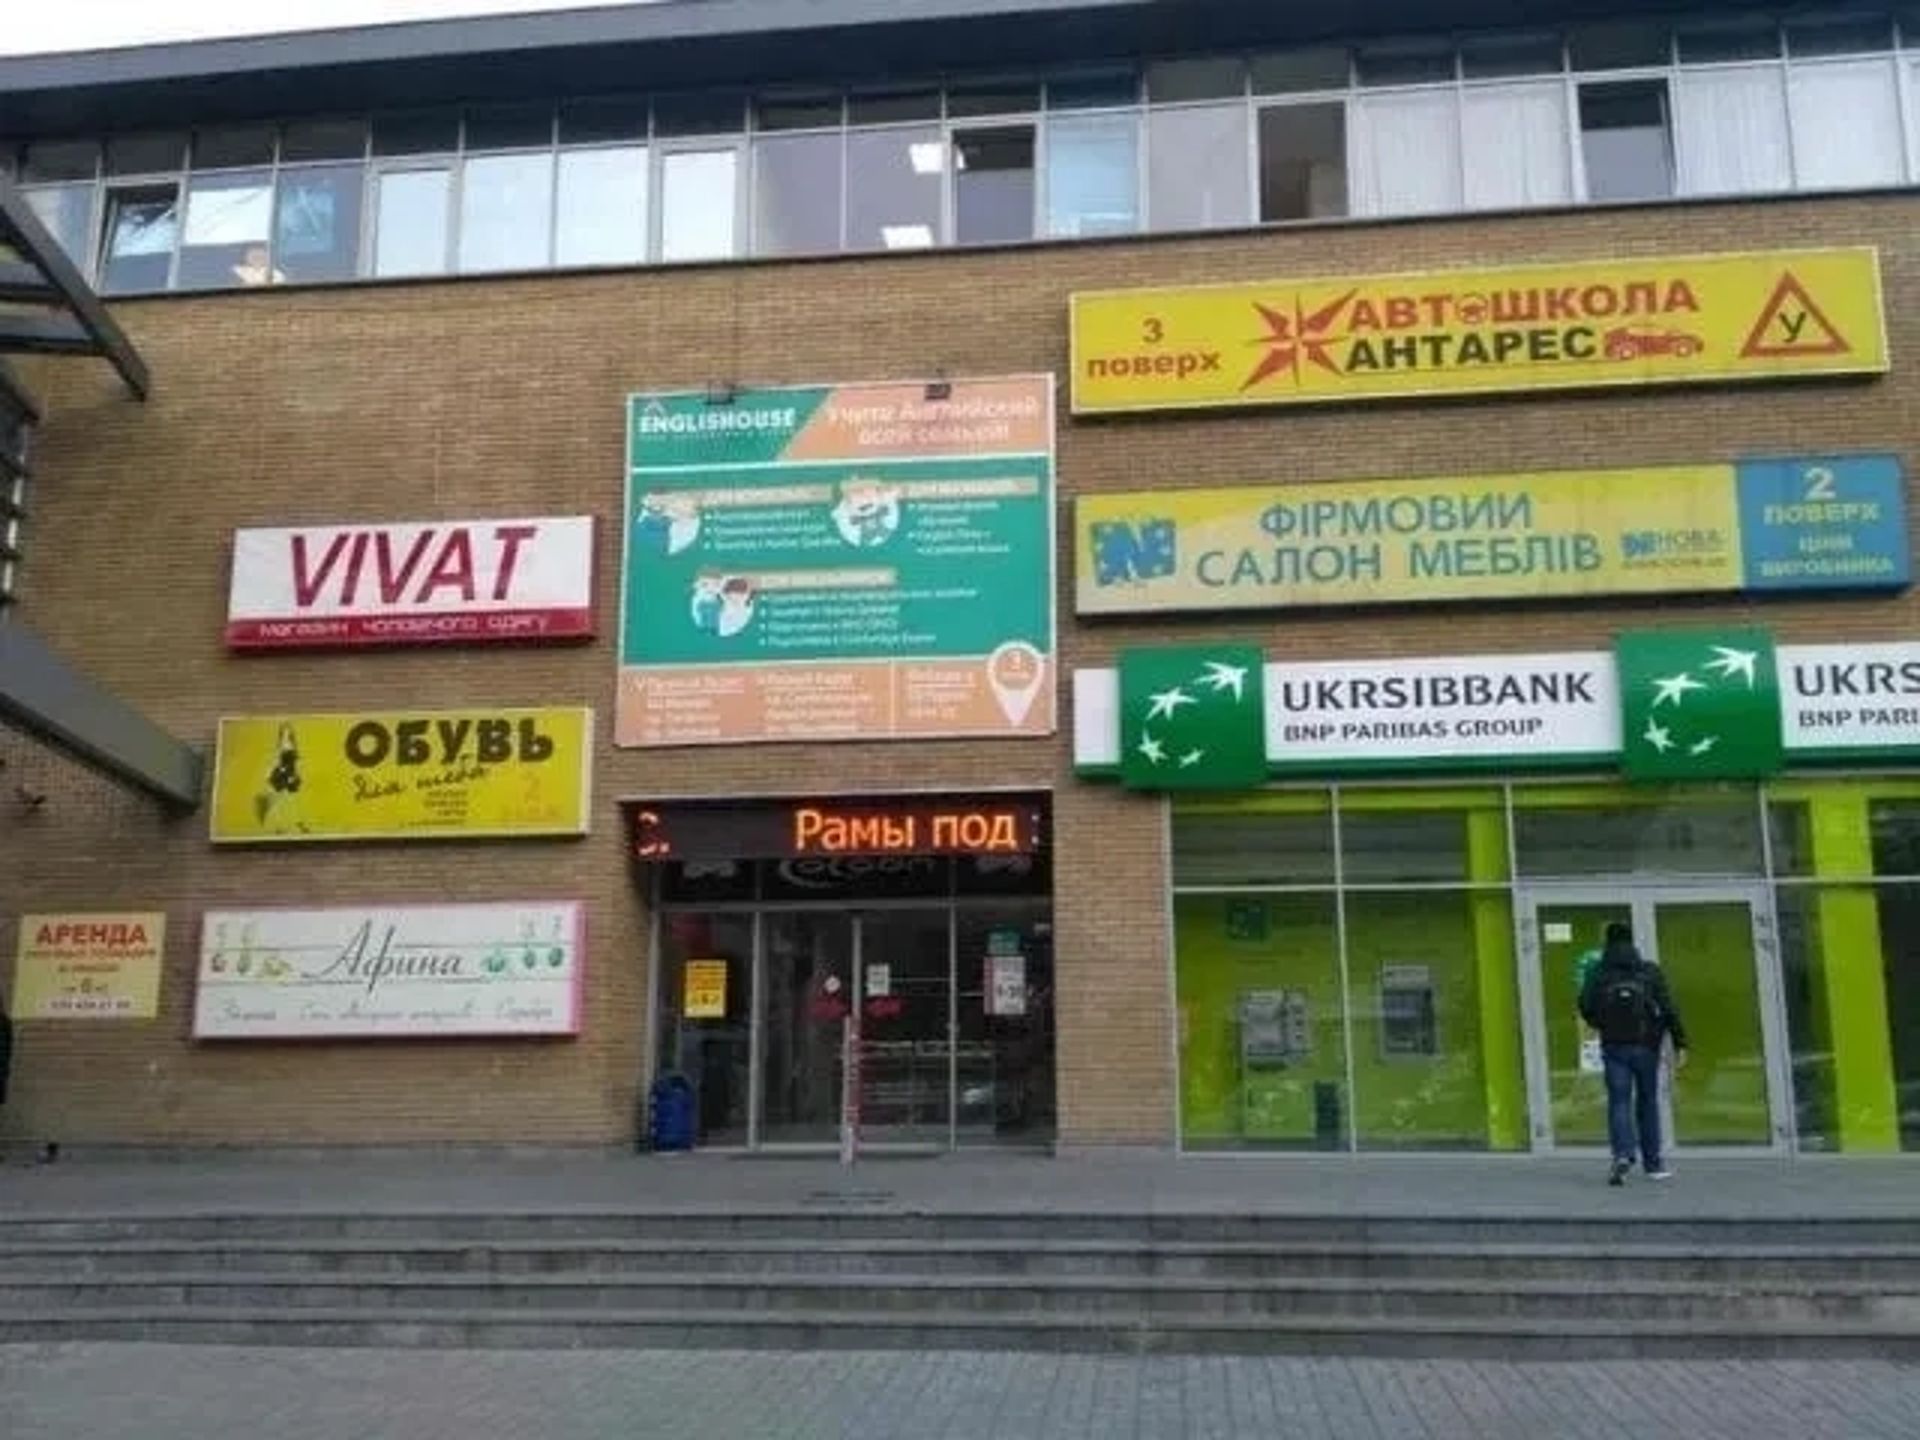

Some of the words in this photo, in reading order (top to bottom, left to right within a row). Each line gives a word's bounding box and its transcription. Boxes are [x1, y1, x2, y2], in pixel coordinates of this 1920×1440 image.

[1348, 278, 1701, 331] АВТОШКОЛА
[1142, 318, 1163, 343] 3
[1778, 311, 1807, 343] У
[1087, 350, 1222, 378] поверх
[1346, 326, 1597, 372] АНТАРЕС
[639, 407, 796, 433] ENGLISHOUSE
[1803, 466, 1837, 500] 2
[1763, 502, 1880, 526] ПОВЕРХ
[291, 526, 537, 608] VIVAT
[1196, 543, 1382, 588] САЛОН
[1409, 533, 1602, 579] МЕБЛІВ
[1282, 671, 1595, 712] UKRSIBBANK
[1794, 661, 1920, 697] UKRS
[1284, 723, 1336, 742] BNP
[1341, 719, 1449, 741] PARIBAS
[1454, 716, 1543, 738] GROUP
[1799, 709, 1853, 729] BNP
[1859, 706, 1918, 726] PARI
[344, 717, 554, 769] ОБУВЬ
[794, 808, 915, 851] Рамы
[932, 812, 1018, 850] под
[36, 922, 148, 947] АРЕНДА
